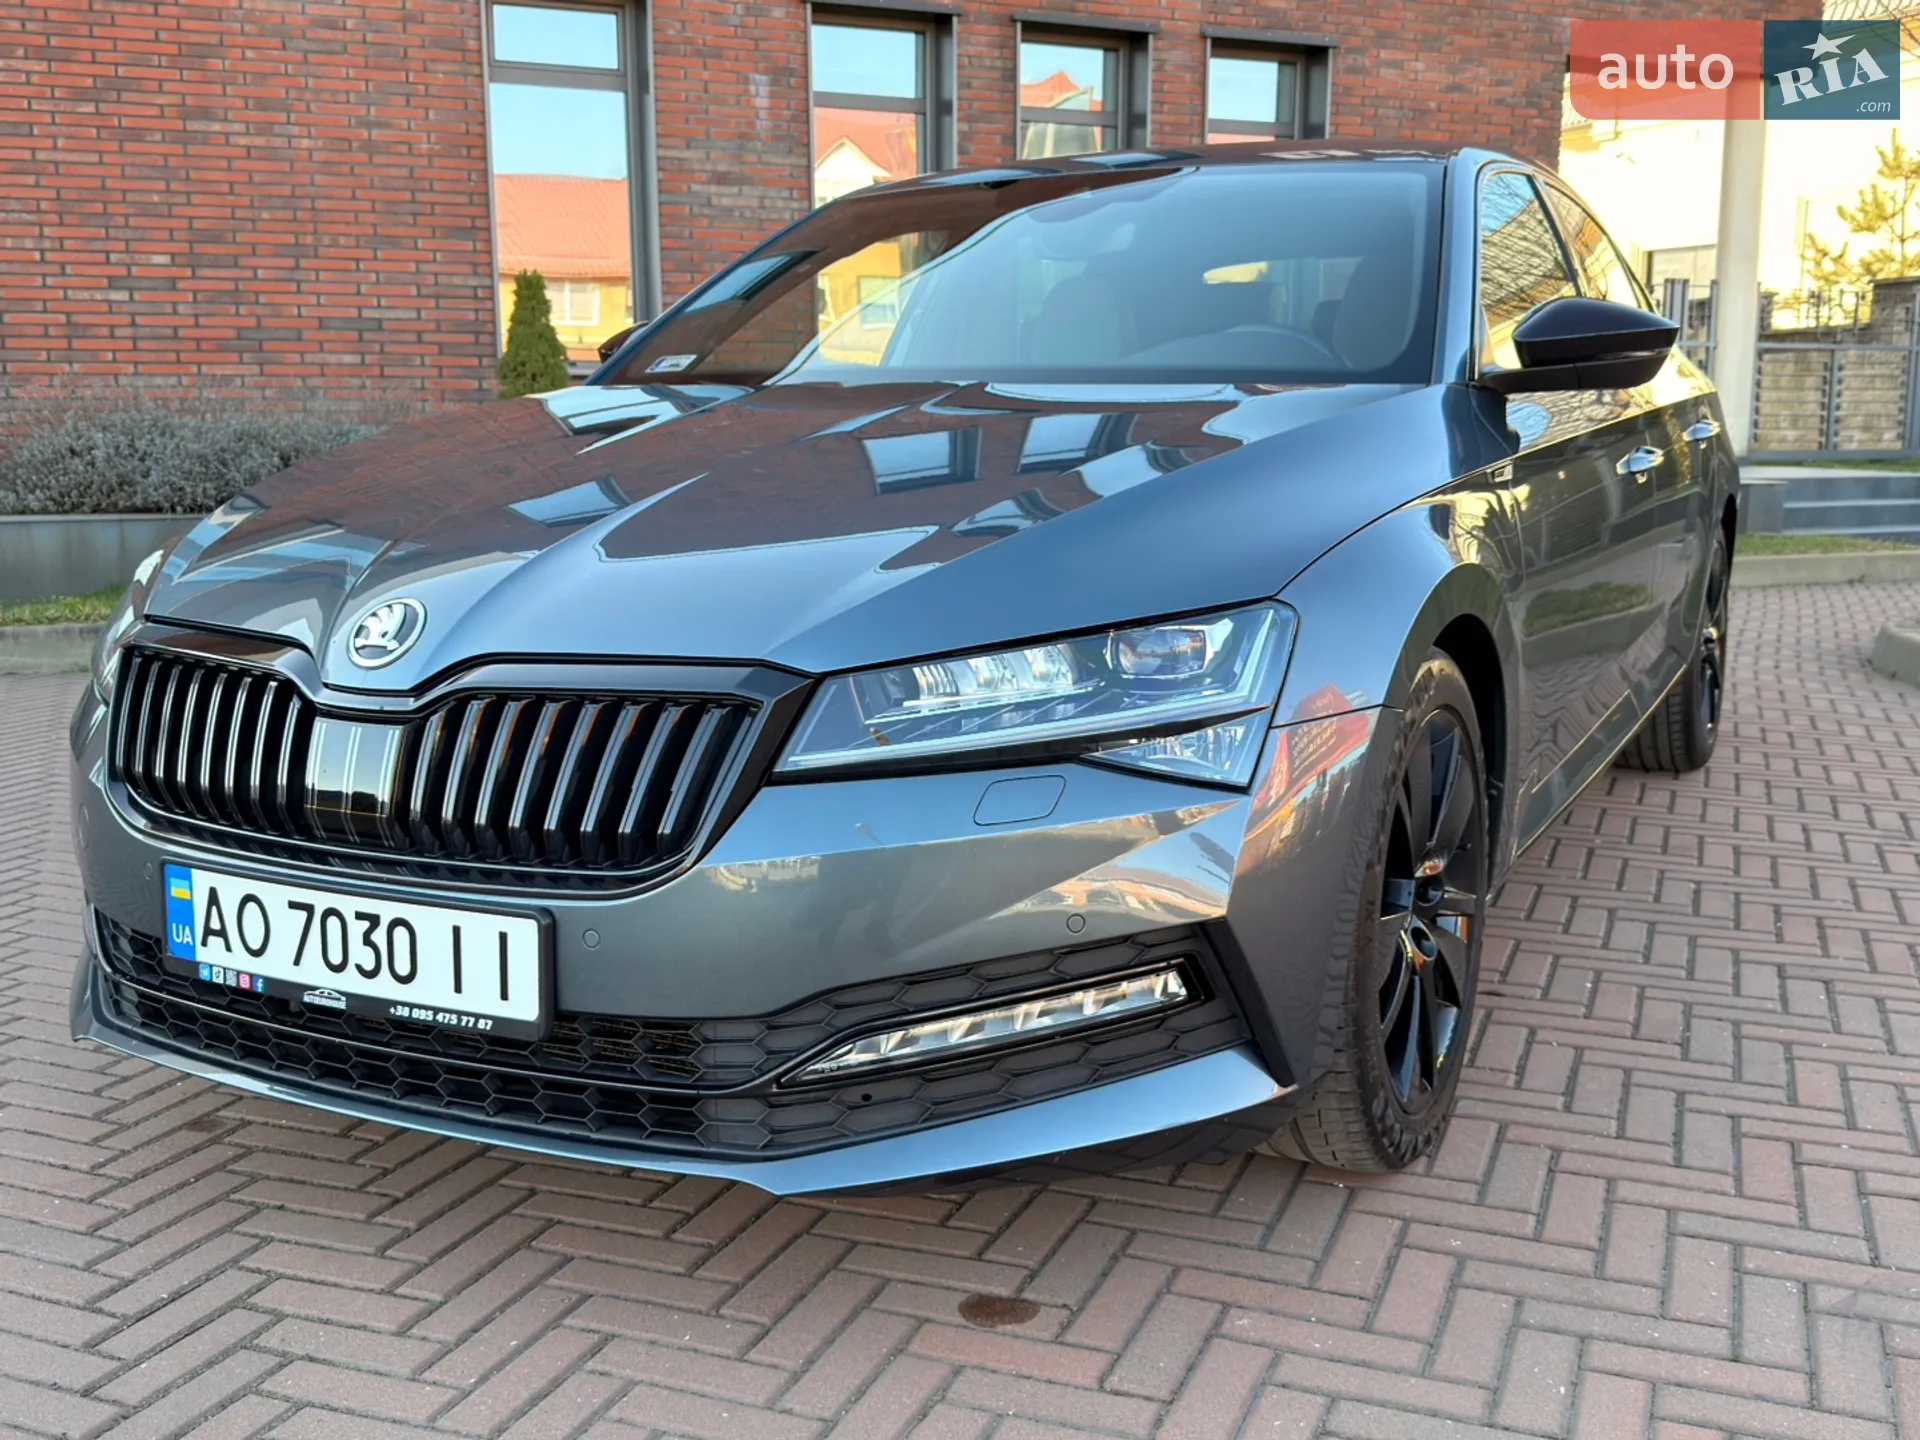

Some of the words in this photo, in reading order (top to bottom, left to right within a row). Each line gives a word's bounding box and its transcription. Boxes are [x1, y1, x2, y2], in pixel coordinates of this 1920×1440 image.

[172, 922, 193, 946] UA
[200, 886, 271, 958] AO
[287, 899, 419, 985] 7030
[389, 1005, 410, 1017] +38
[411, 1008, 434, 1021] 095
[435, 1012, 458, 1025] 475
[461, 1016, 475, 1028] 77
[477, 1018, 493, 1030] 87
